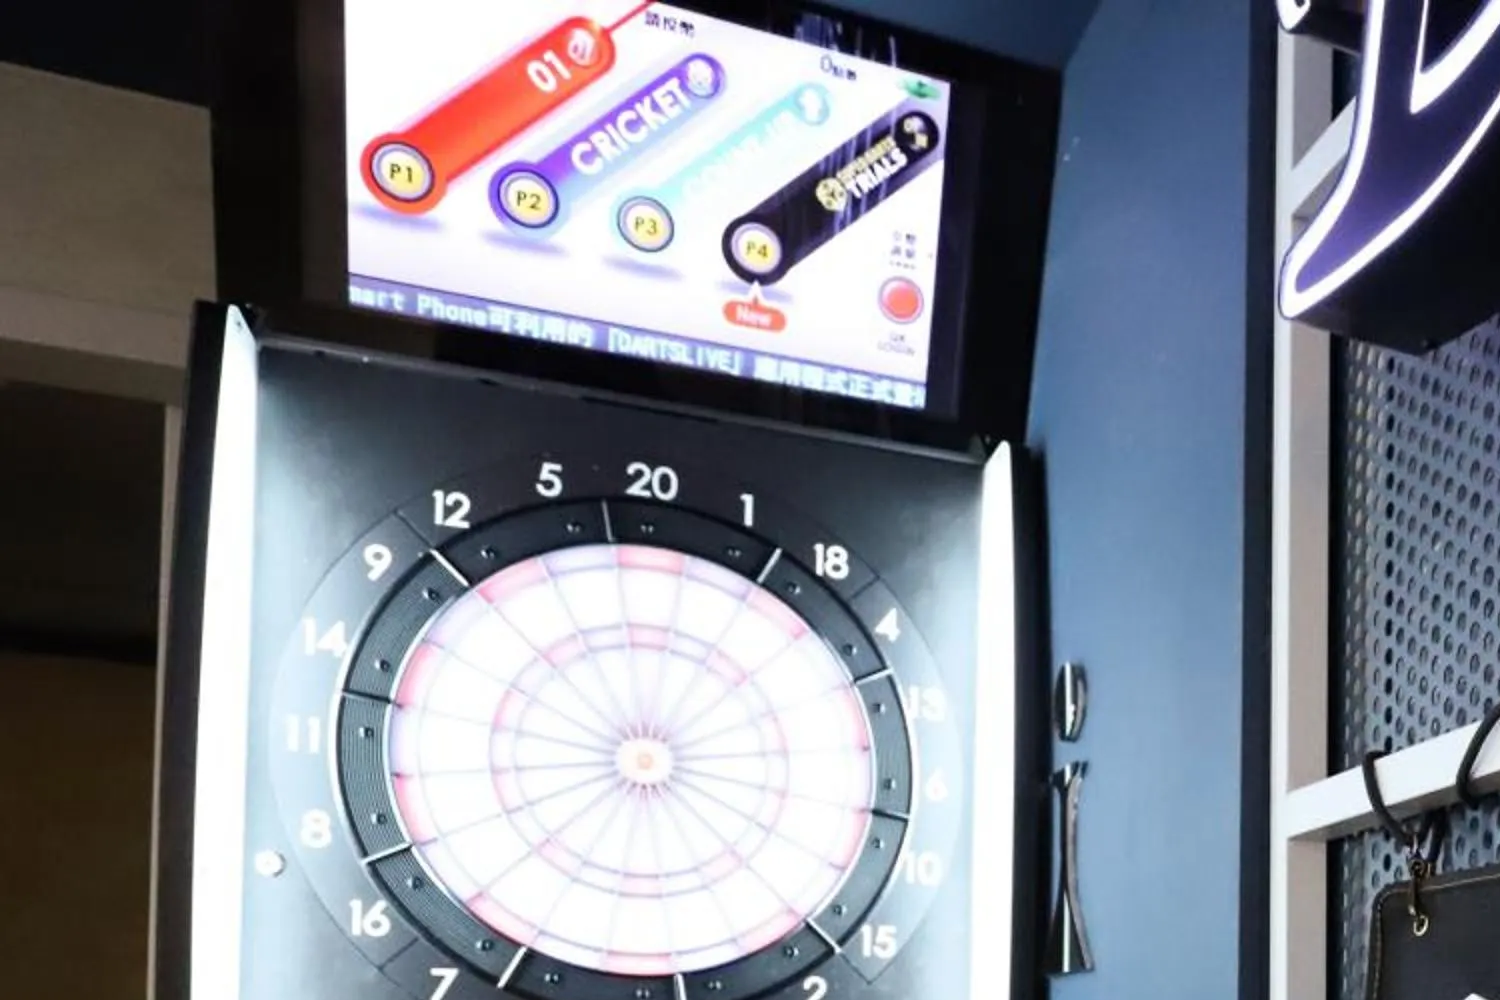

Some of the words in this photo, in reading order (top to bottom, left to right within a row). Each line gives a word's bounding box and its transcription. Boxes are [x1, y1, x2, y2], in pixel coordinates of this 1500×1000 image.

[526, 49, 572, 93] 01
[570, 76, 694, 175] CRICKET
[389, 162, 414, 184] P1
[845, 147, 908, 199] TRIALS
[516, 190, 541, 211] P2
[634, 216, 659, 236] P3
[745, 242, 768, 261] P4
[536, 463, 564, 497] 5
[624, 463, 680, 501] 20
[432, 490, 472, 530] 12
[739, 493, 756, 527] 1
[363, 543, 394, 581] 9
[812, 543, 850, 578] 18
[302, 618, 348, 659] 14
[874, 609, 901, 641] 4
[908, 688, 947, 721] 13
[284, 718, 321, 752] 11
[924, 771, 948, 801] 6
[299, 811, 333, 846] 8
[902, 851, 943, 885] 10
[349, 900, 391, 938] 16
[861, 925, 899, 959] 15
